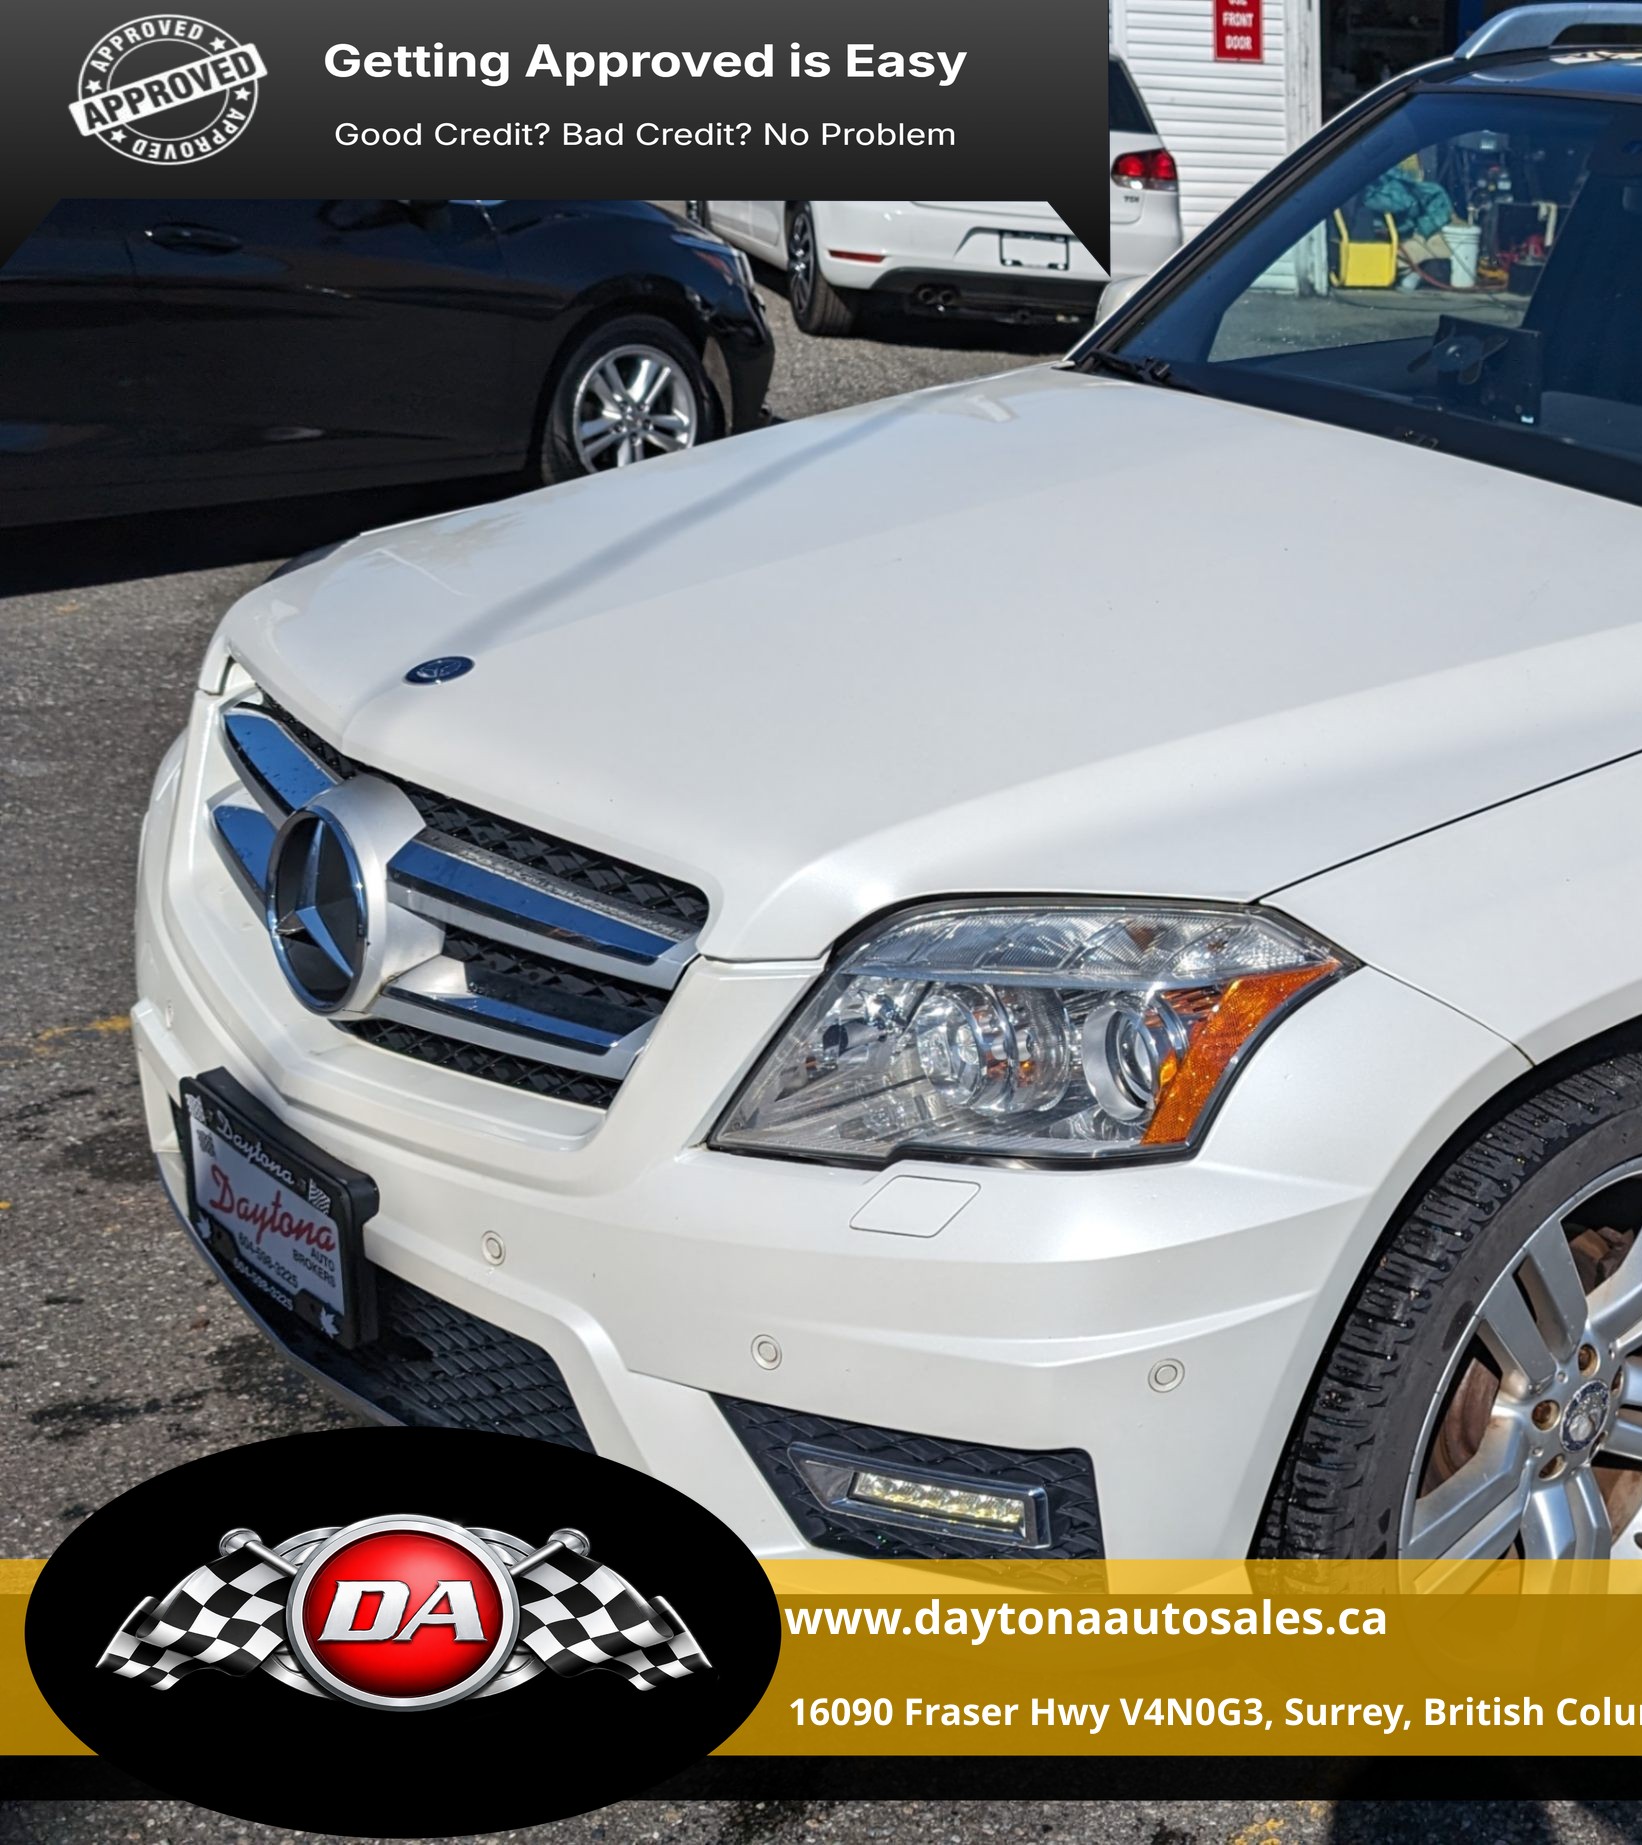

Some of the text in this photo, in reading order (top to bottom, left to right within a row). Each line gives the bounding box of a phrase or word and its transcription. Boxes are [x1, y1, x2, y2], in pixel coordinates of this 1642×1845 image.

[1222, 11, 1254, 27] FRONT
[1225, 35, 1252, 50] DOOR
[216, 1109, 295, 1186] Daytona
[209, 1164, 337, 1252] Daytona
[292, 1248, 337, 1288] BROKERS
[310, 1247, 335, 1272] AUTO
